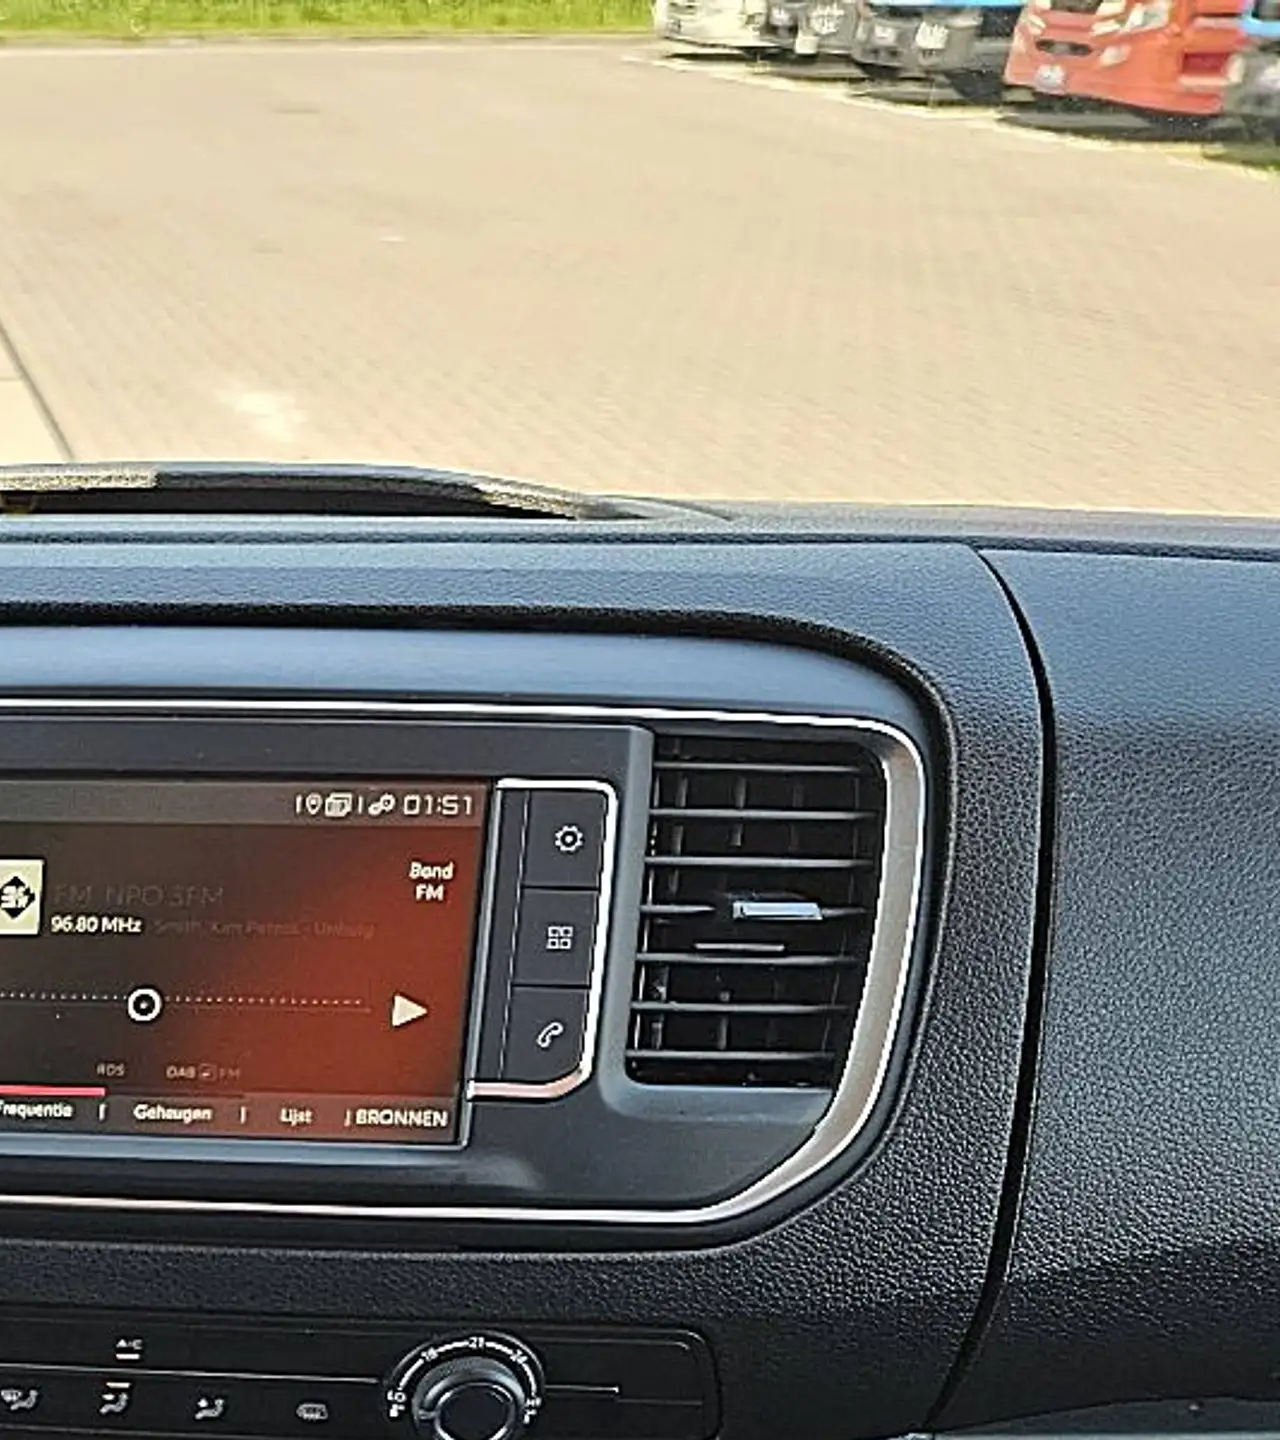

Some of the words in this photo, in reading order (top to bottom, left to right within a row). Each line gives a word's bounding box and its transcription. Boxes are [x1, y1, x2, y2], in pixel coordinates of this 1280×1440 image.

[403, 794, 472, 816] 01:51
[415, 883, 444, 900] FM
[51, 915, 98, 933] 96.80
[101, 916, 142, 933] MHz
[133, 1102, 213, 1124] Geheugen
[279, 1107, 313, 1127] Lijst
[355, 1108, 448, 1128] BRONNEN
[468, 1336, 486, 1349] 21
